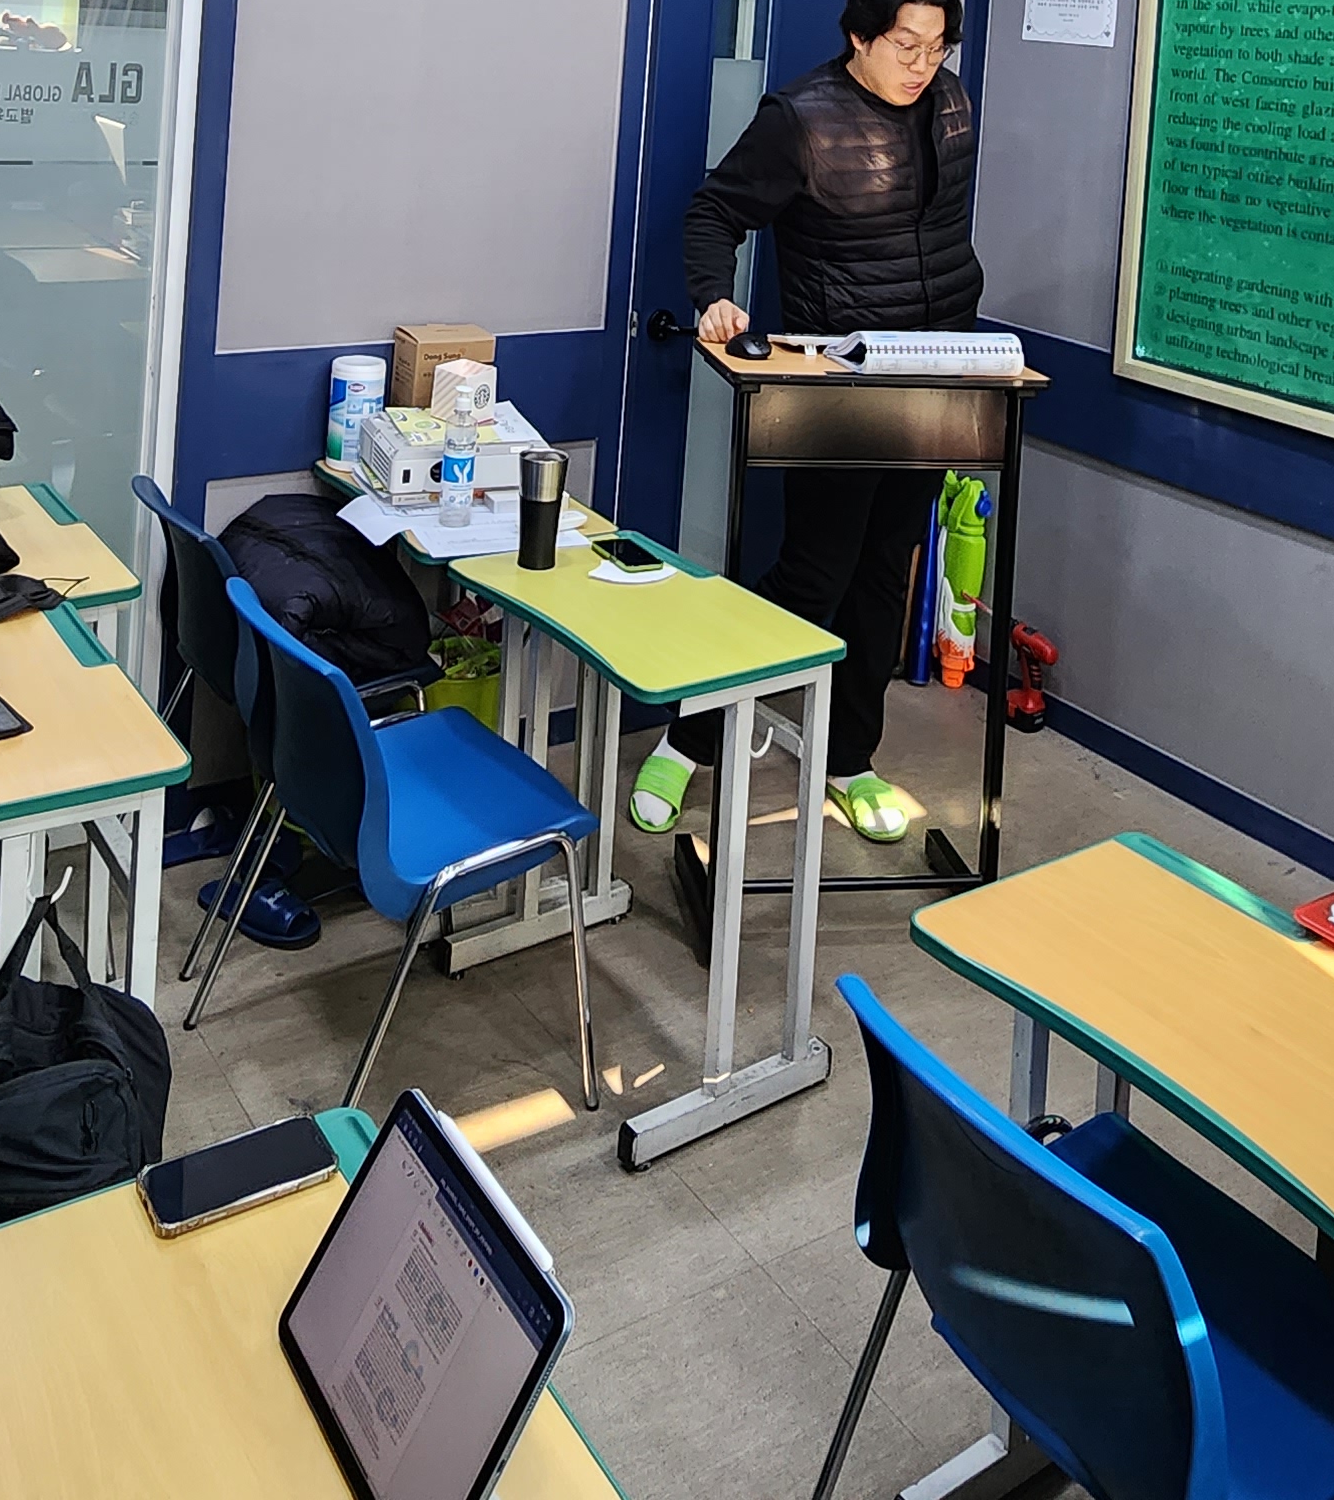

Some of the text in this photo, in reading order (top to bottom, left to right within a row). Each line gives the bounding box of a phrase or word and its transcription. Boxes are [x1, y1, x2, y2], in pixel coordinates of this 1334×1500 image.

[1247, 0, 1281, 14] while
[1175, 22, 1215, 37] vapour
[1220, 23, 1234, 38] by
[1240, 25, 1270, 37] trees
[1275, 25, 1299, 39] and
[1174, 44, 1233, 59] vegetation
[1238, 48, 1250, 59] to
[1255, 47, 1282, 62] both
[1288, 50, 1324, 66] shade
[1171, 262, 1233, 289] integrating
[1237, 277, 1299, 304] gardening
[1303, 290, 1333, 308] with
[1165, 334, 1213, 357] utilizing
[1217, 345, 1299, 378] technological
